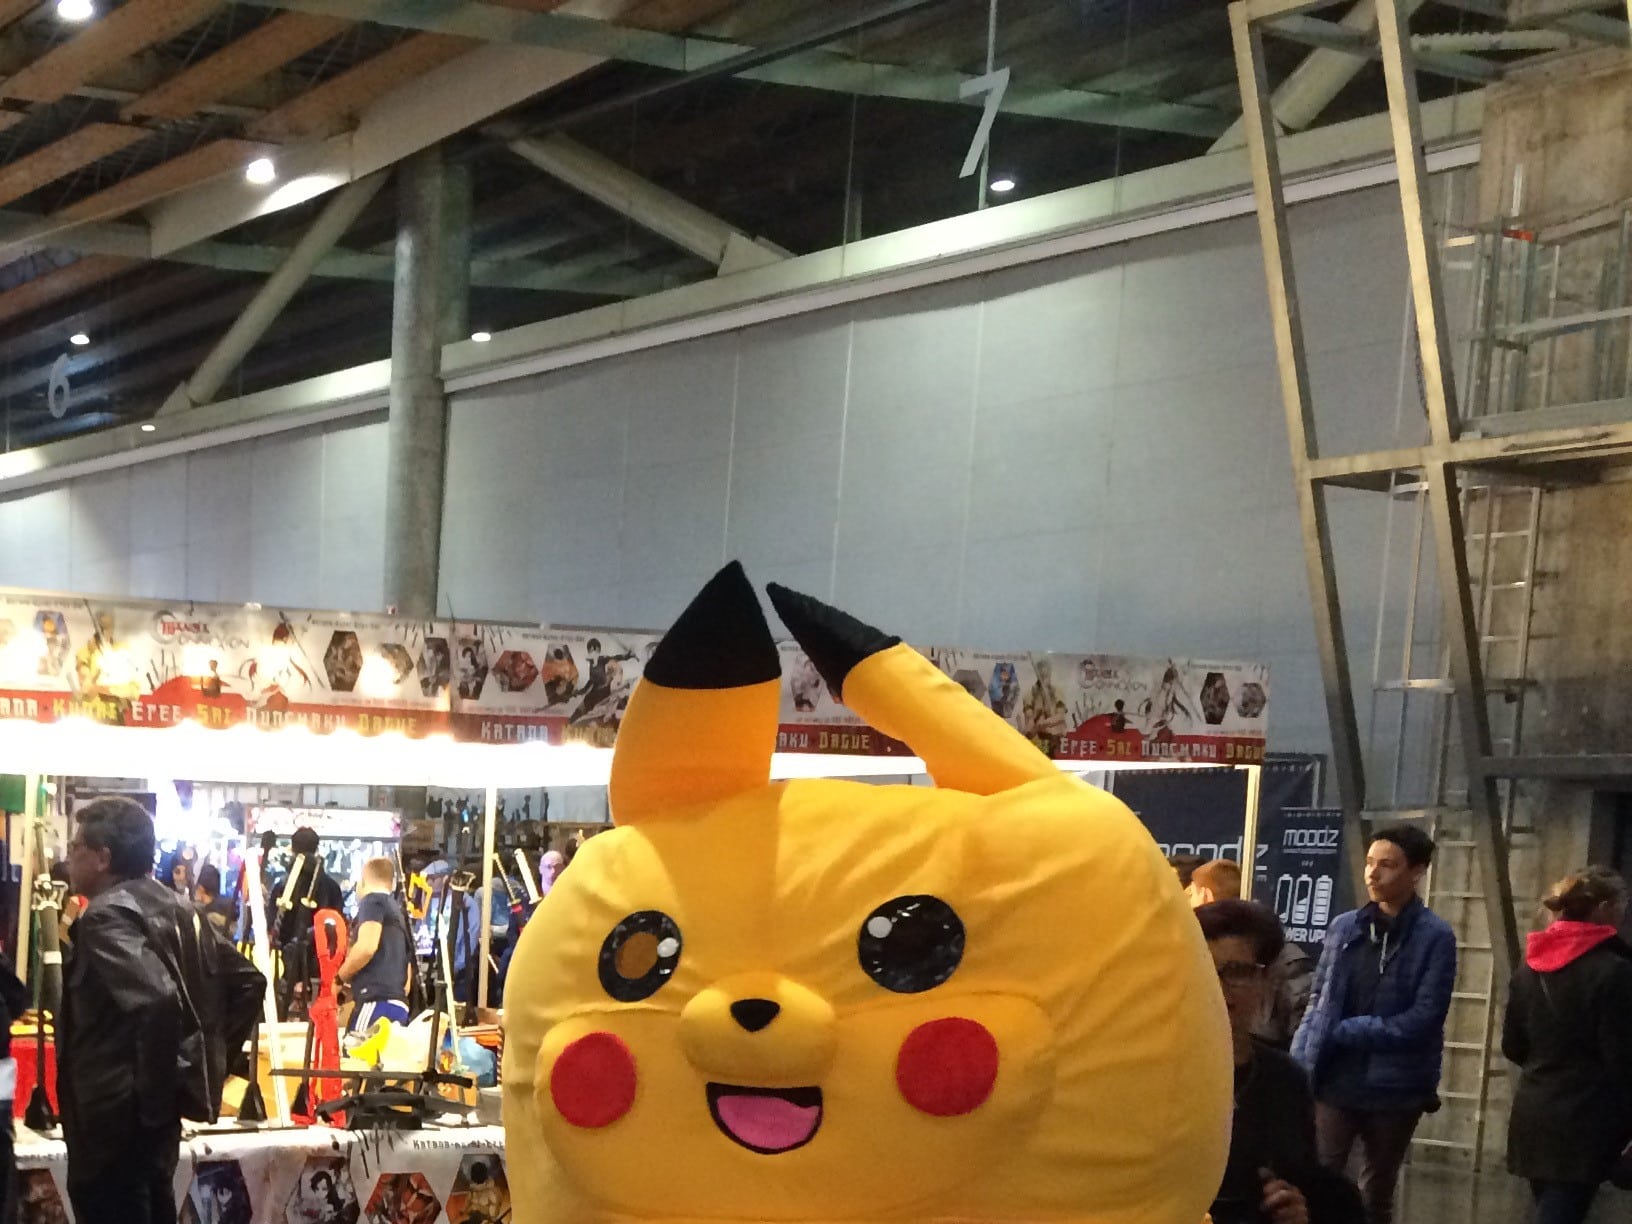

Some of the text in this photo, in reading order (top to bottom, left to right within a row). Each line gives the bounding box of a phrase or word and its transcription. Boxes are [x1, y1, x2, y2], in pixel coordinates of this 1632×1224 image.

[958, 66, 1010, 178] 7
[48, 352, 70, 418] 6
[481, 721, 549, 741] KATANA
[819, 731, 870, 749] DAGUE
[1283, 826, 1339, 847] moodz
